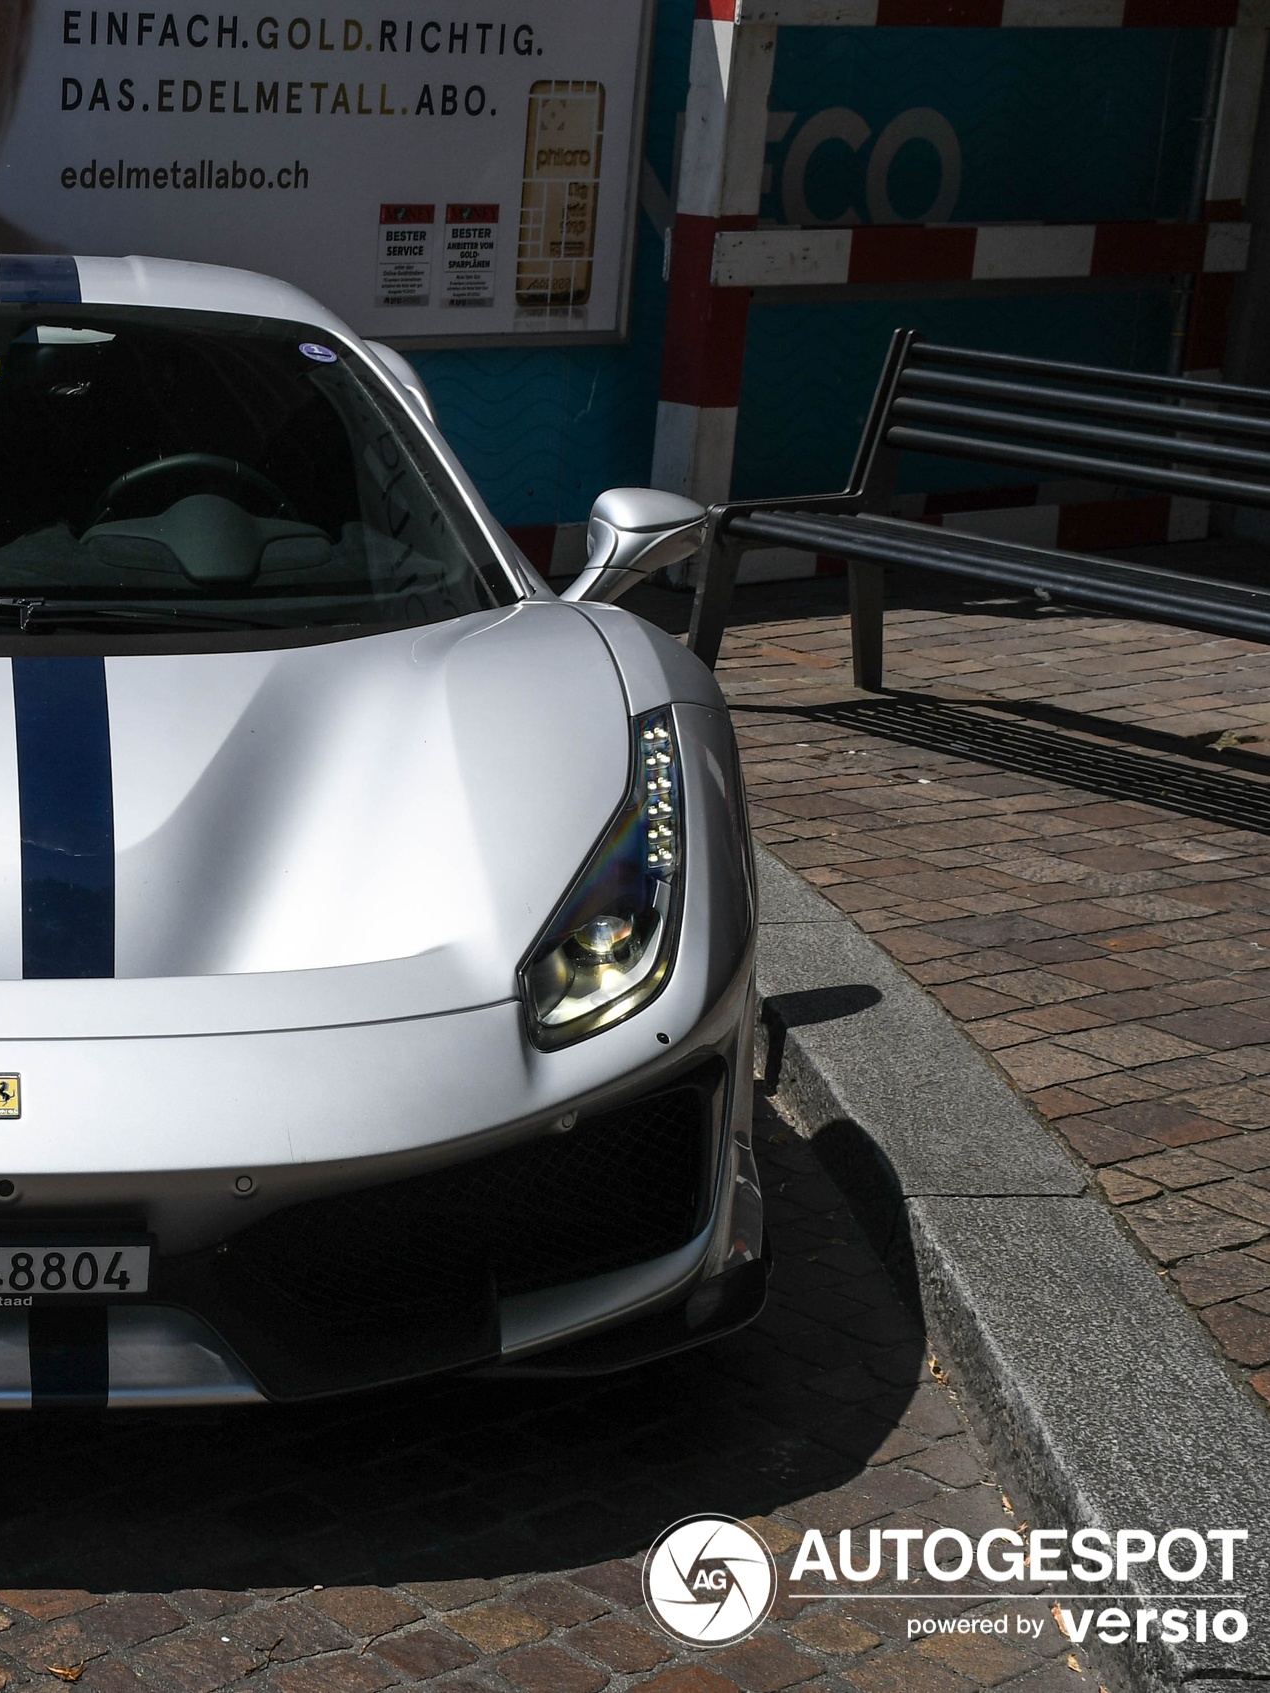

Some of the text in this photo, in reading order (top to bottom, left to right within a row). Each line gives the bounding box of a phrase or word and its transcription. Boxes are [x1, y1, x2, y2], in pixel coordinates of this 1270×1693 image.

[62, 10, 544, 57] EINFACH.GOLD.RICHTIG.
[60, 77, 497, 117] DAS.EDELMETALL.ABO.
[60, 159, 309, 190] edelmetallabo.ch
[385, 230, 427, 241] BESTER
[451, 228, 491, 239] BESTER
[386, 245, 424, 256] SERVICE
[447, 242, 494, 250] ANBIETER VON
[460, 251, 480, 259] GOLD-
[448, 259, 490, 269] SPARPLÄNEN
